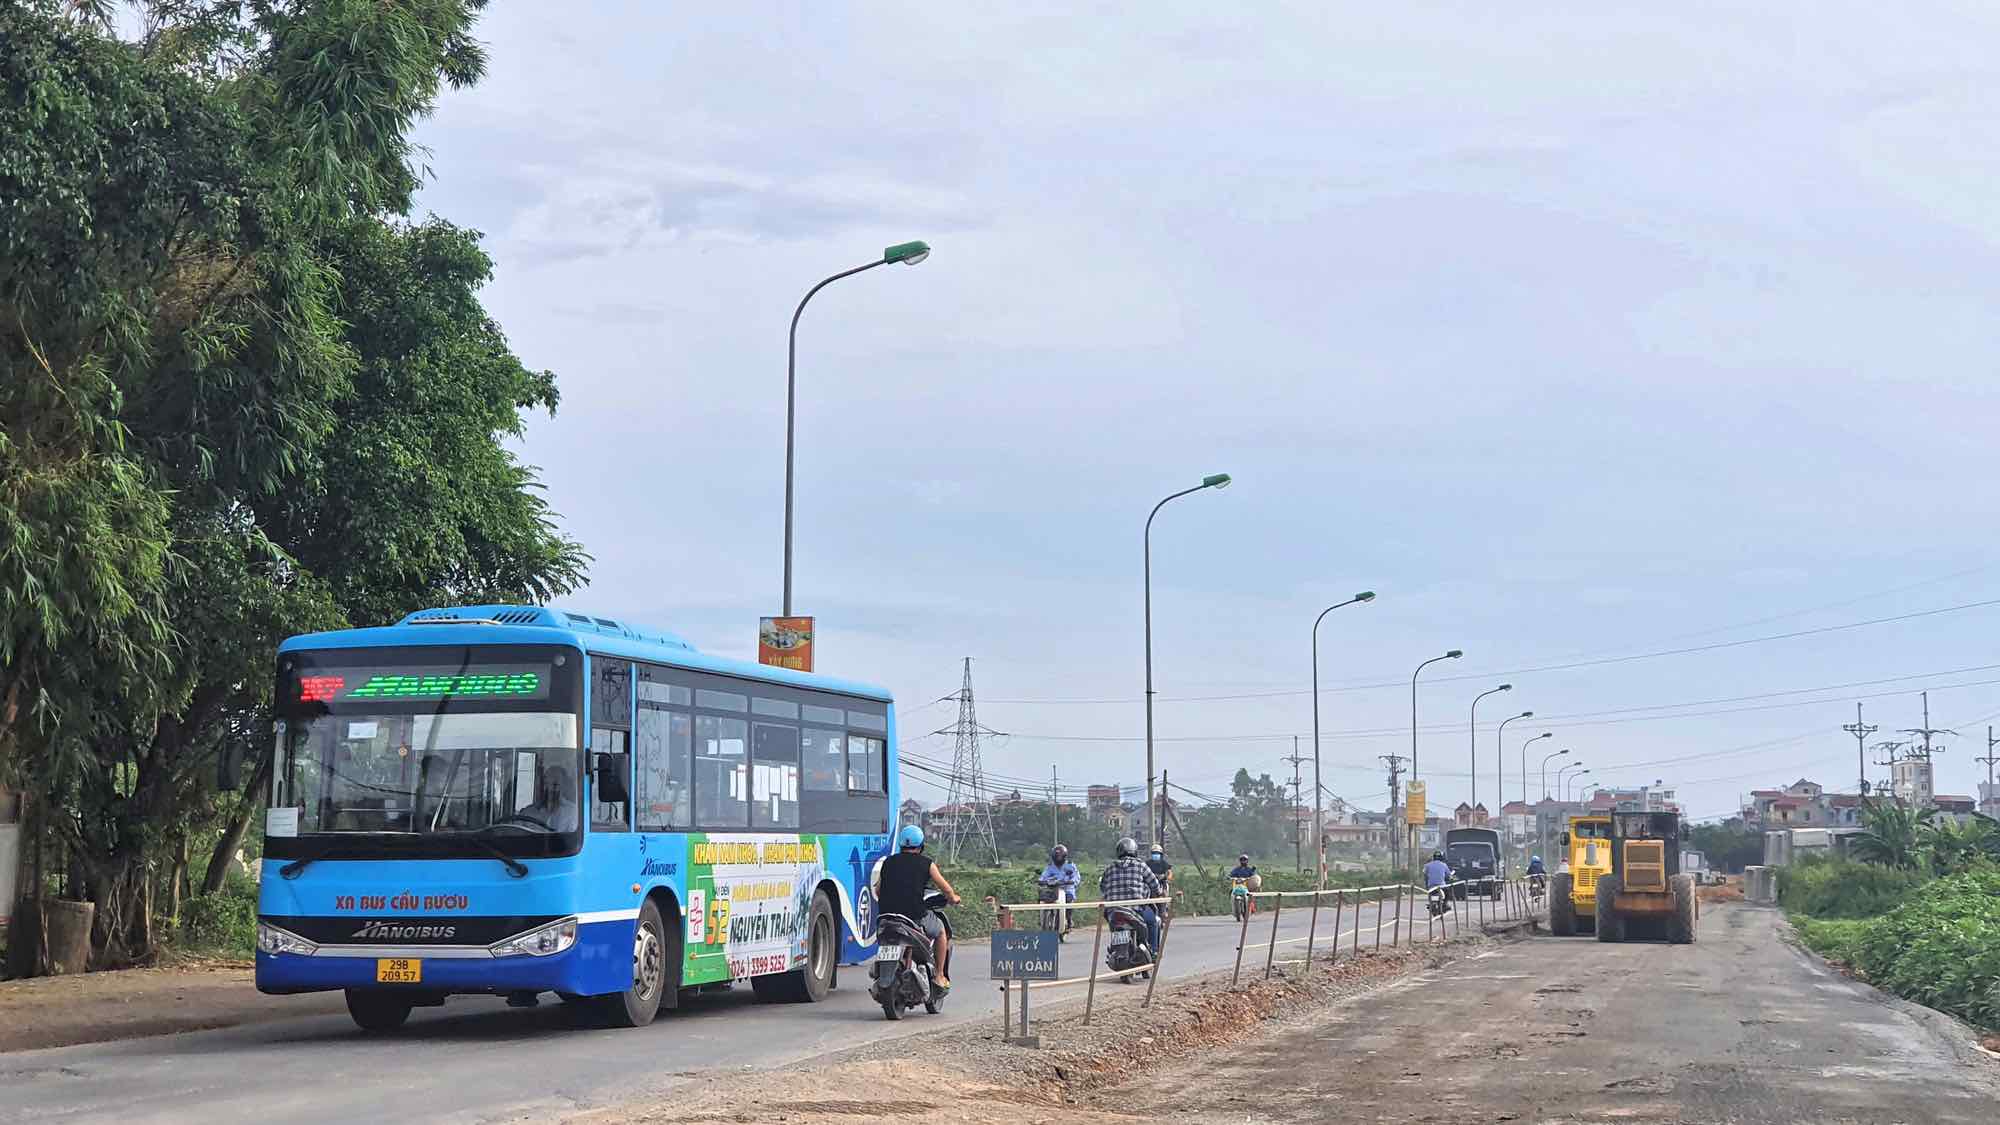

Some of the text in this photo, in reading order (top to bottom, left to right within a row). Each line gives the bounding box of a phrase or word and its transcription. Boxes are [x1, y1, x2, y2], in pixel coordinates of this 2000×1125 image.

[361, 896, 386, 909] BUS
[707, 899, 729, 944] 52
[352, 922, 456, 938] HANOIBUS
[389, 960, 409, 970] 29B
[997, 960, 1014, 972] AN
